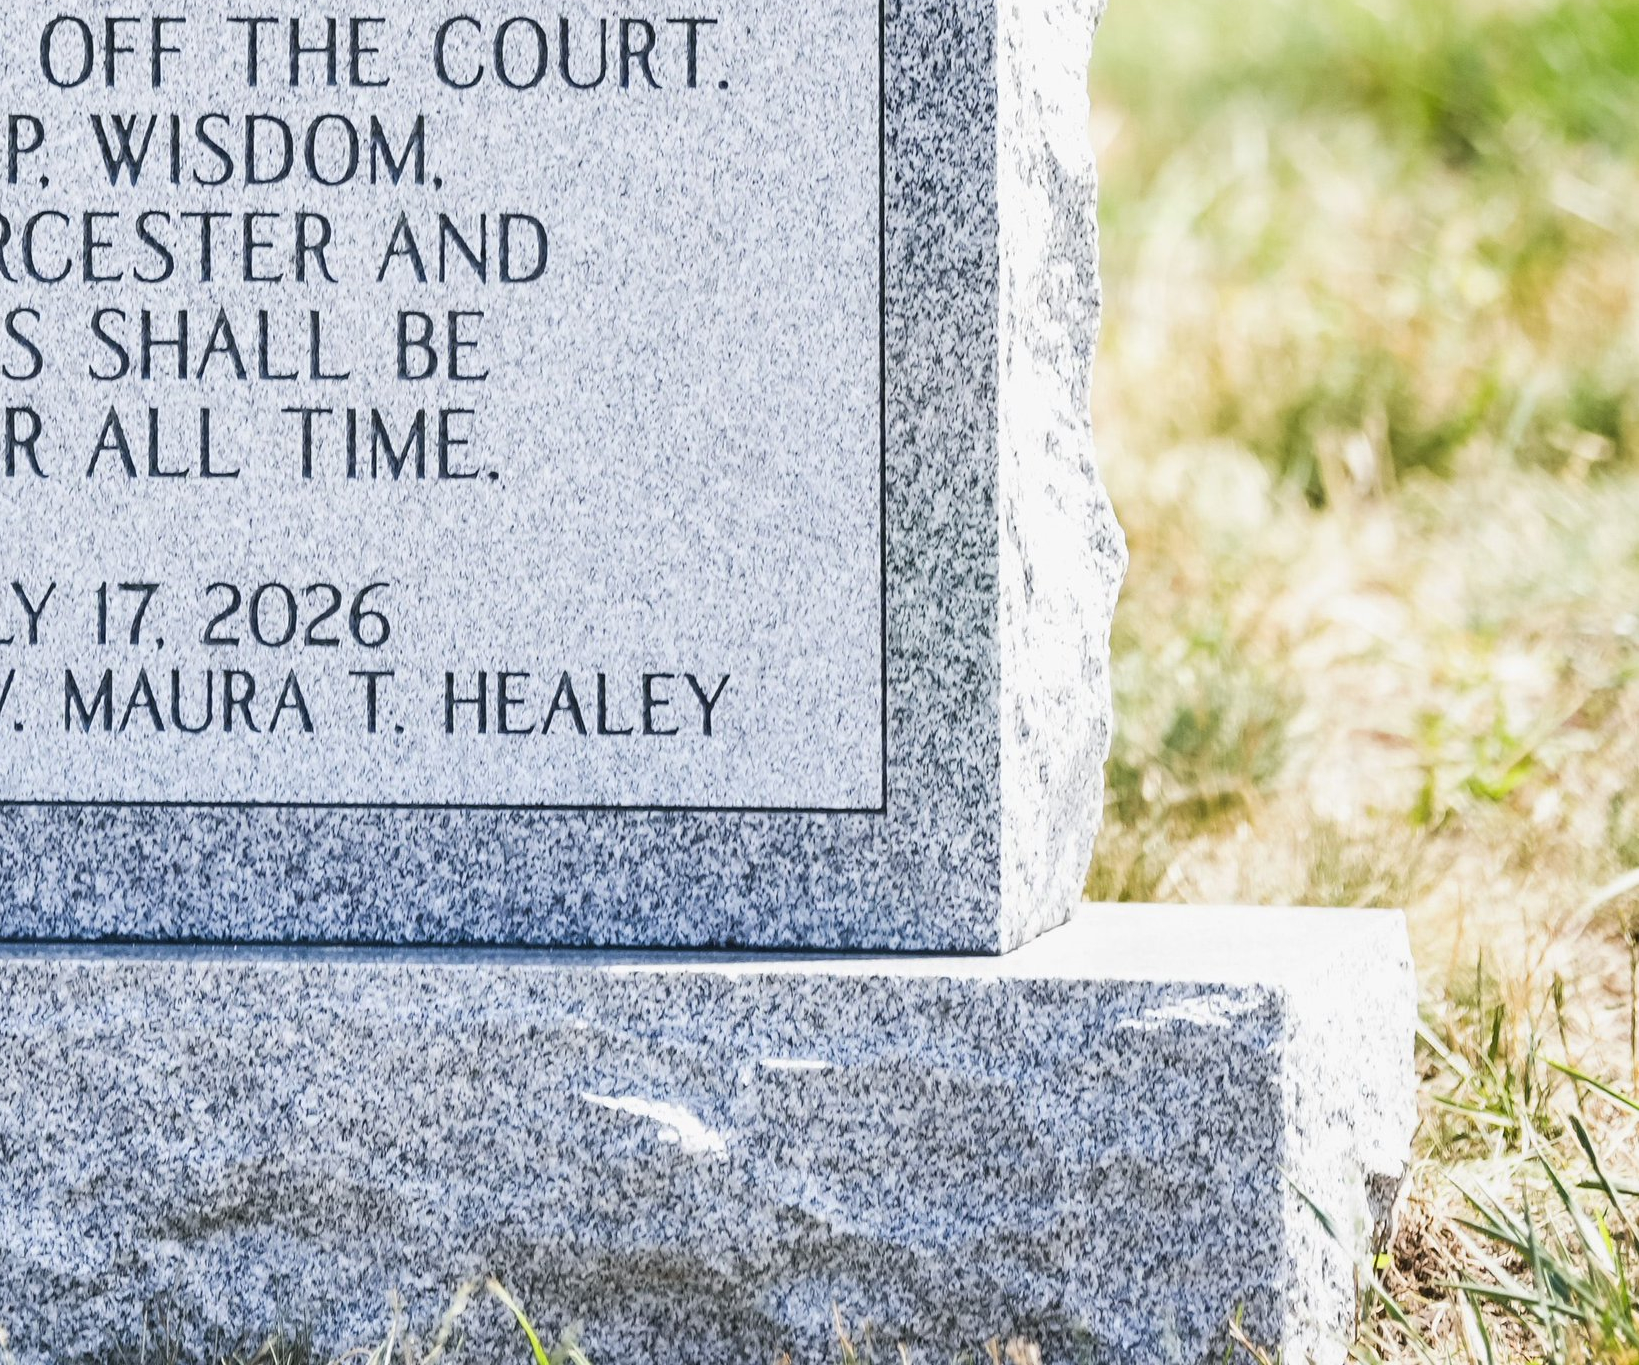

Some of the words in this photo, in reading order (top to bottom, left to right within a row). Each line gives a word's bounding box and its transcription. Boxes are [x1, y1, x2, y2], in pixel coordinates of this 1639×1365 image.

[39, 13, 186, 90] OFF
[227, 15, 390, 88] THE
[433, 13, 731, 92] COURT.
[376, 211, 549, 284] AND
[88, 307, 351, 382] SHALL
[396, 309, 490, 382] BE
[85, 406, 240, 479] ALL
[282, 406, 501, 482] TIME.
[201, 580, 391, 650] 2026
[63, 667, 315, 736] MAURA
[348, 668, 406, 735] T.
[443, 670, 731, 737] HEALEY
